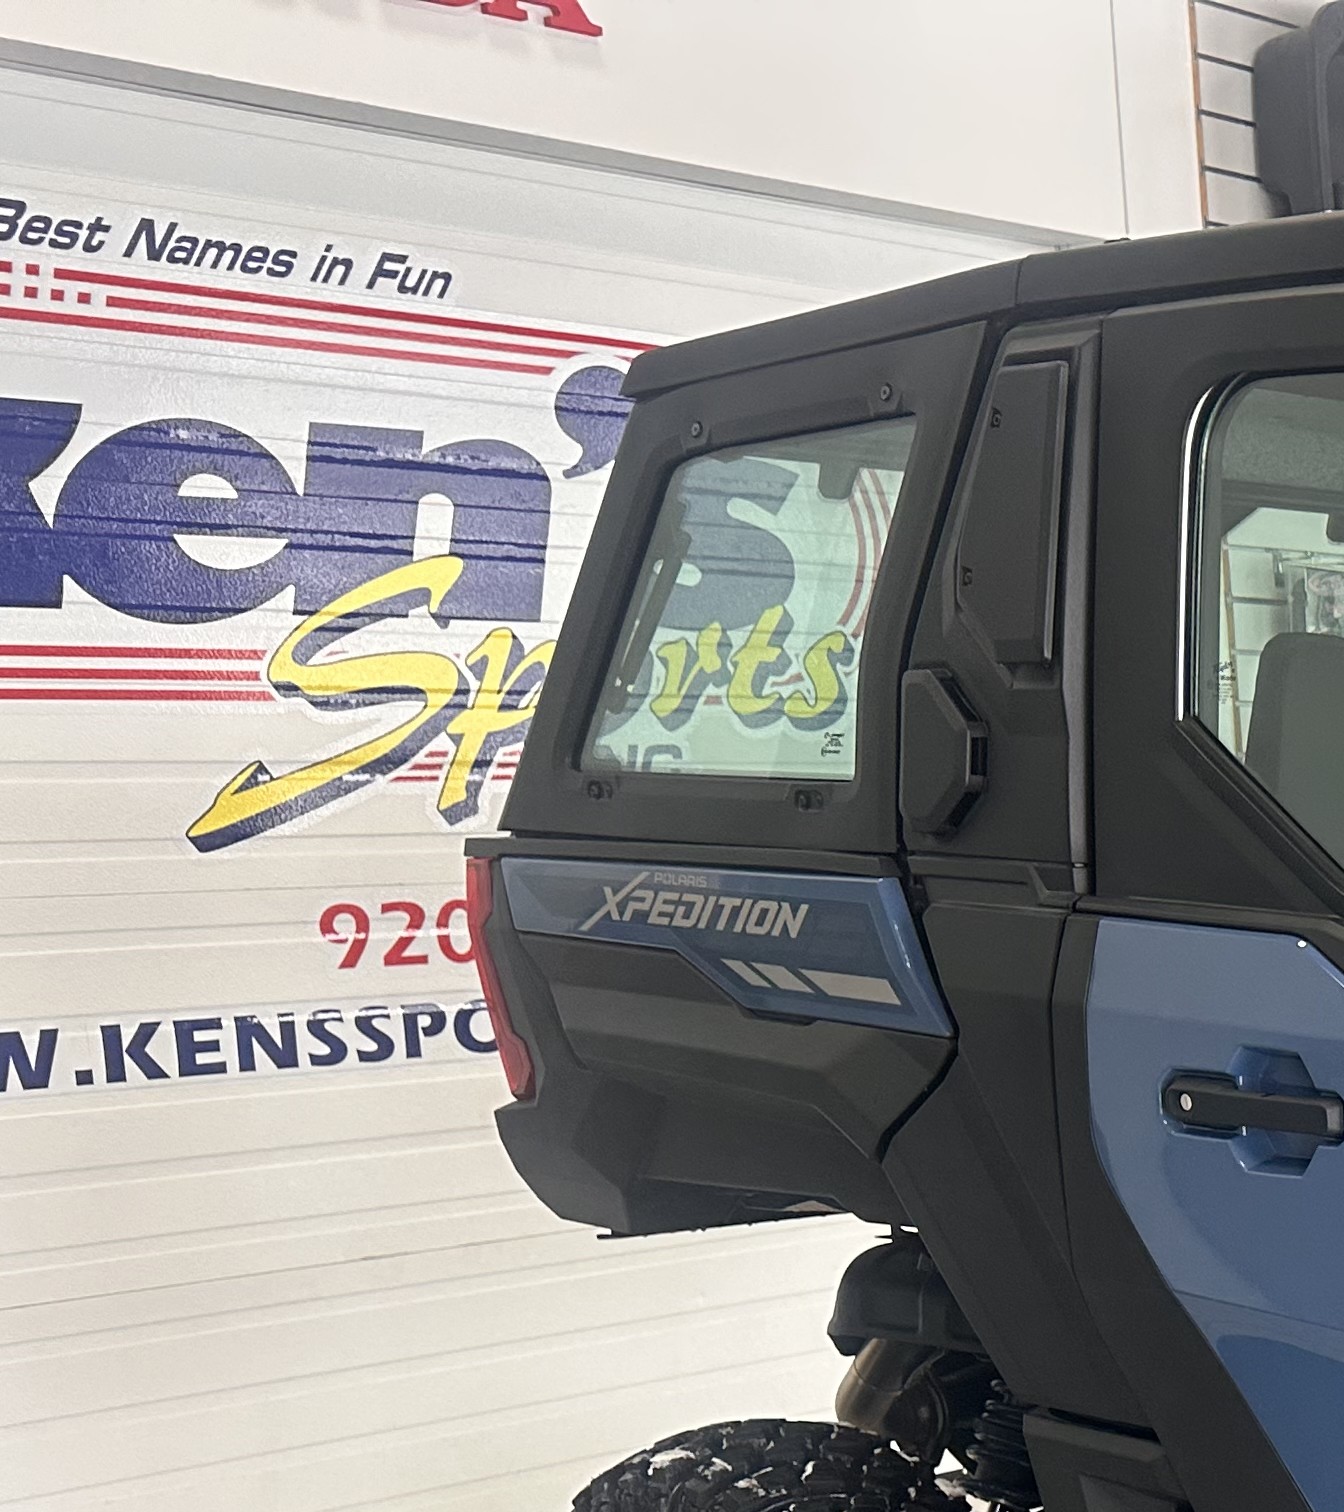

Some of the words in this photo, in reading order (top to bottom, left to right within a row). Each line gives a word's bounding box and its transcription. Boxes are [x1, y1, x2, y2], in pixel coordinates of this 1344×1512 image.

[0, 198, 112, 253] Best
[122, 217, 298, 278] Names
[310, 244, 354, 286] in
[366, 251, 452, 299] Fun
[186, 554, 856, 853] Sprts
[578, 871, 809, 939] XPEDITION
[654, 871, 707, 889] POLARIS
